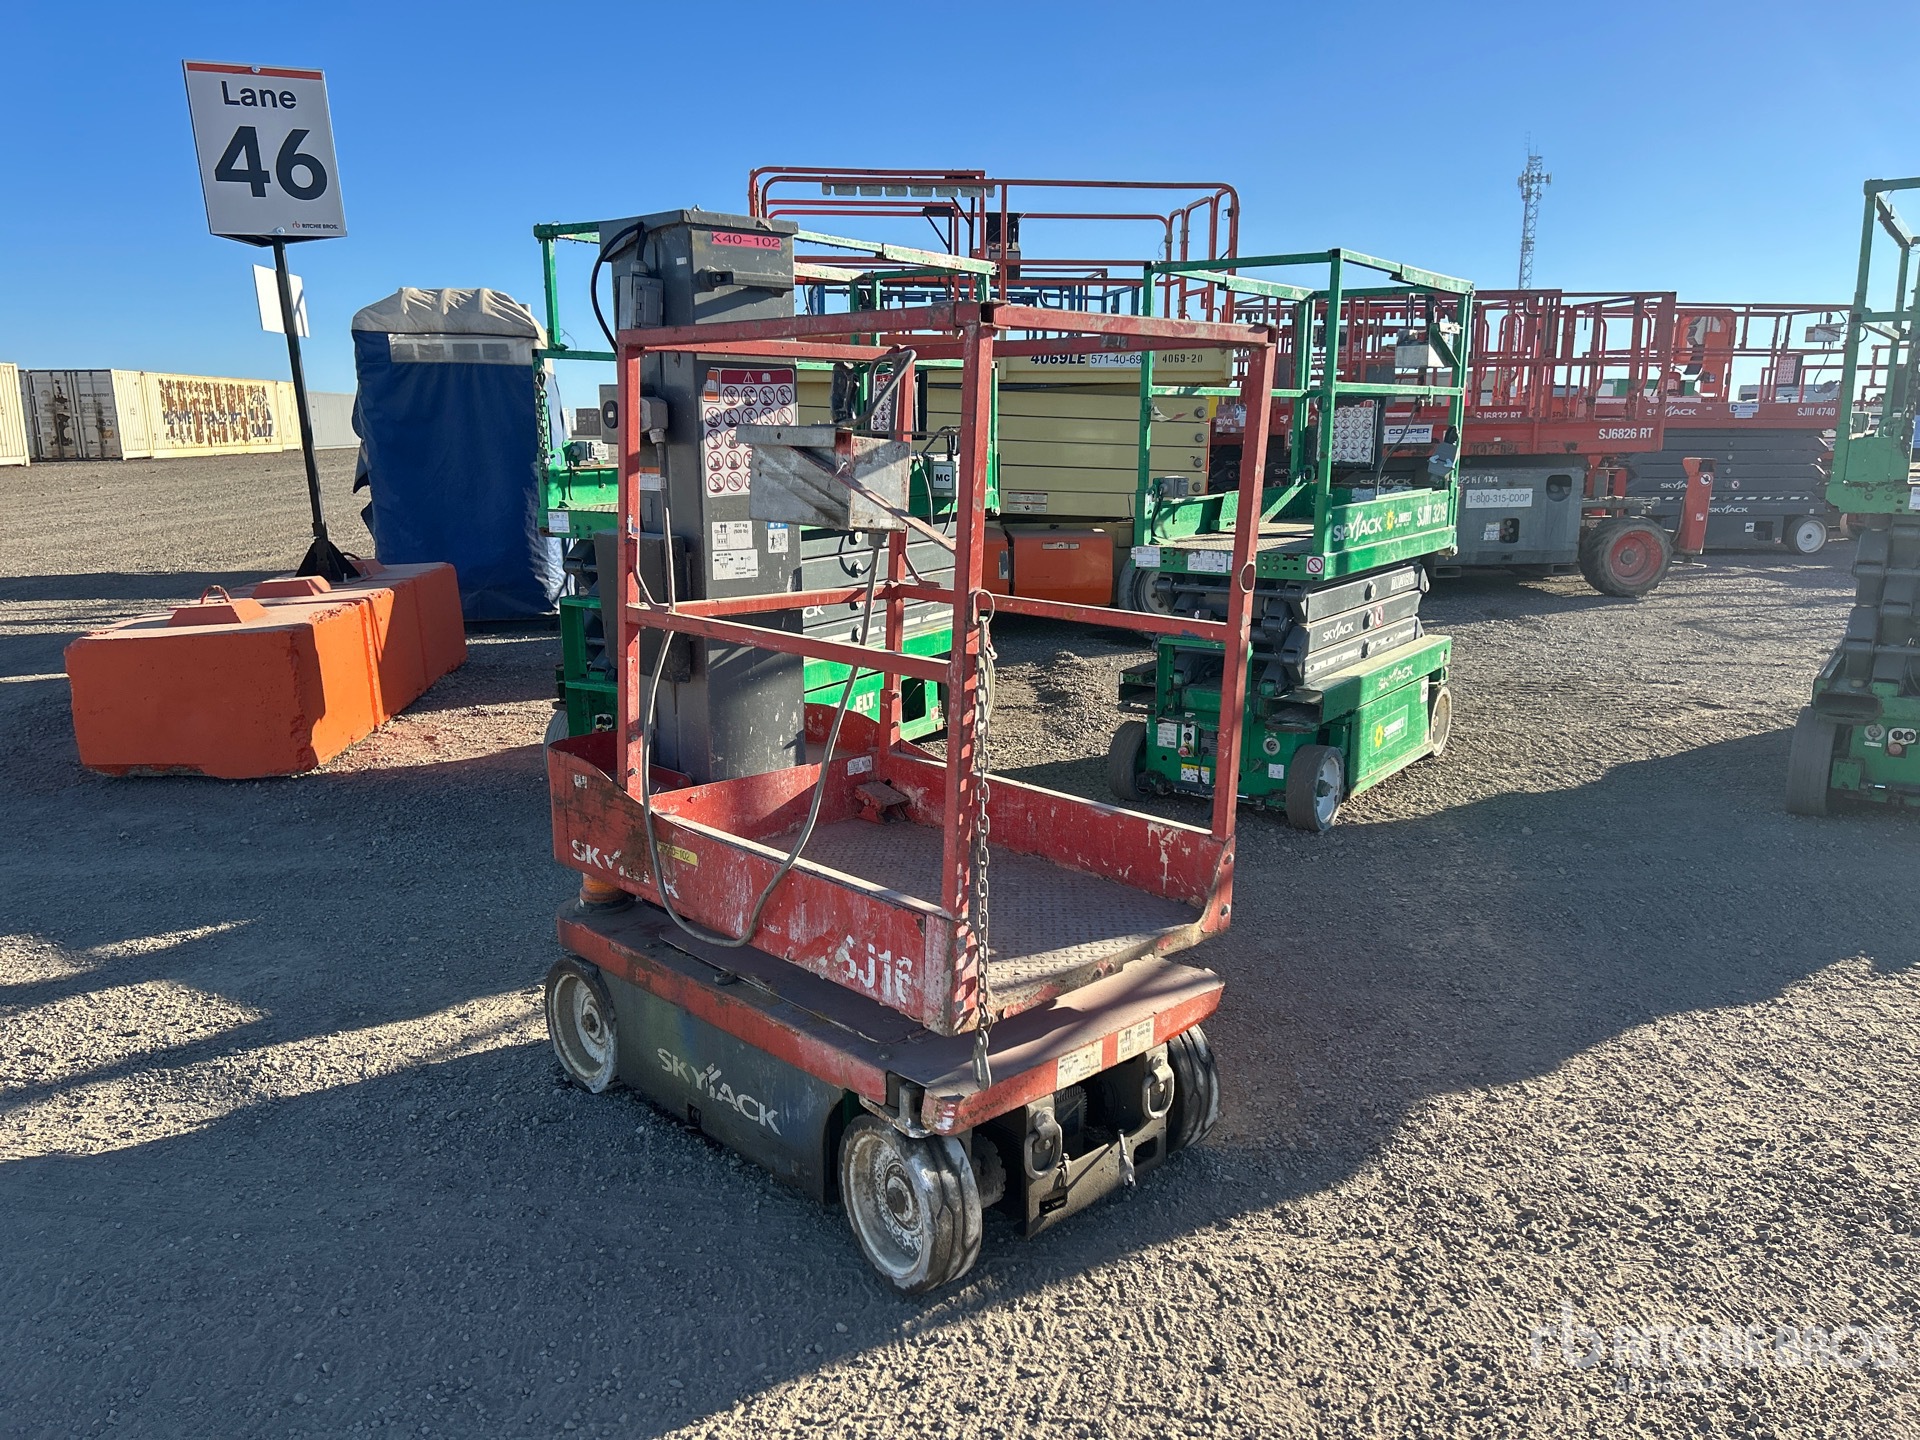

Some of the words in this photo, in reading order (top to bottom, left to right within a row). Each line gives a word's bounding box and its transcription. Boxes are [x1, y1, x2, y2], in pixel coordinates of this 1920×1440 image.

[221, 81, 297, 109] Lane
[214, 125, 328, 201] 46
[711, 232, 781, 248] K40-102
[1030, 353, 1086, 365] 4069LE
[1162, 354, 1203, 364] 4069-20
[1816, 407, 1836, 416] 4740
[1598, 428, 1637, 440] SJ6826
[1639, 428, 1654, 438] RT
[935, 474, 951, 482] MC
[1469, 493, 1530, 503] 1-800-315-COOP
[1707, 504, 1749, 515] SKYJACK
[1333, 510, 1383, 542] SKYJACK
[1322, 620, 1354, 642] SKYJACK
